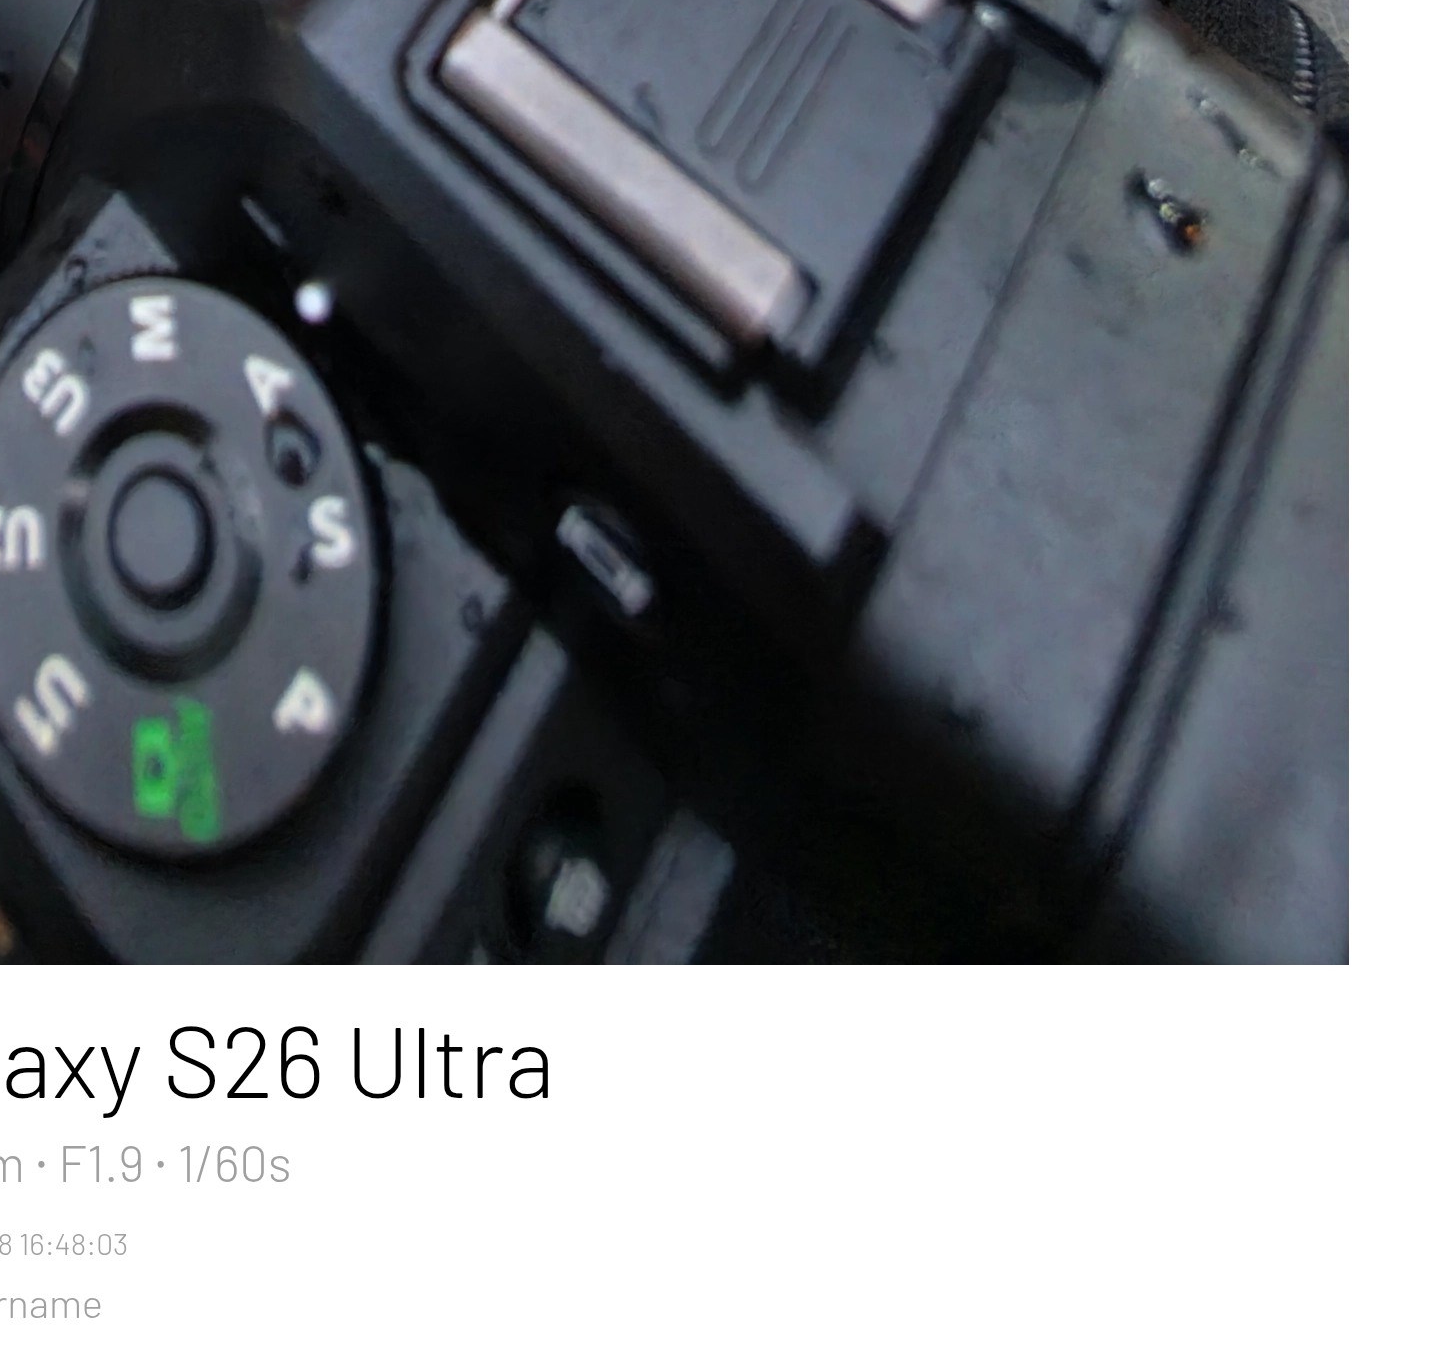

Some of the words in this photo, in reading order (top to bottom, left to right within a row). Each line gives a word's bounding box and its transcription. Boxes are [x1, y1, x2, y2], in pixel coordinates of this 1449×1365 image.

[128, 295, 180, 362] M
[22, 348, 91, 436] U3
[243, 354, 295, 416] A
[307, 496, 355, 568] S
[14, 653, 91, 757] U1
[273, 668, 334, 735] P
